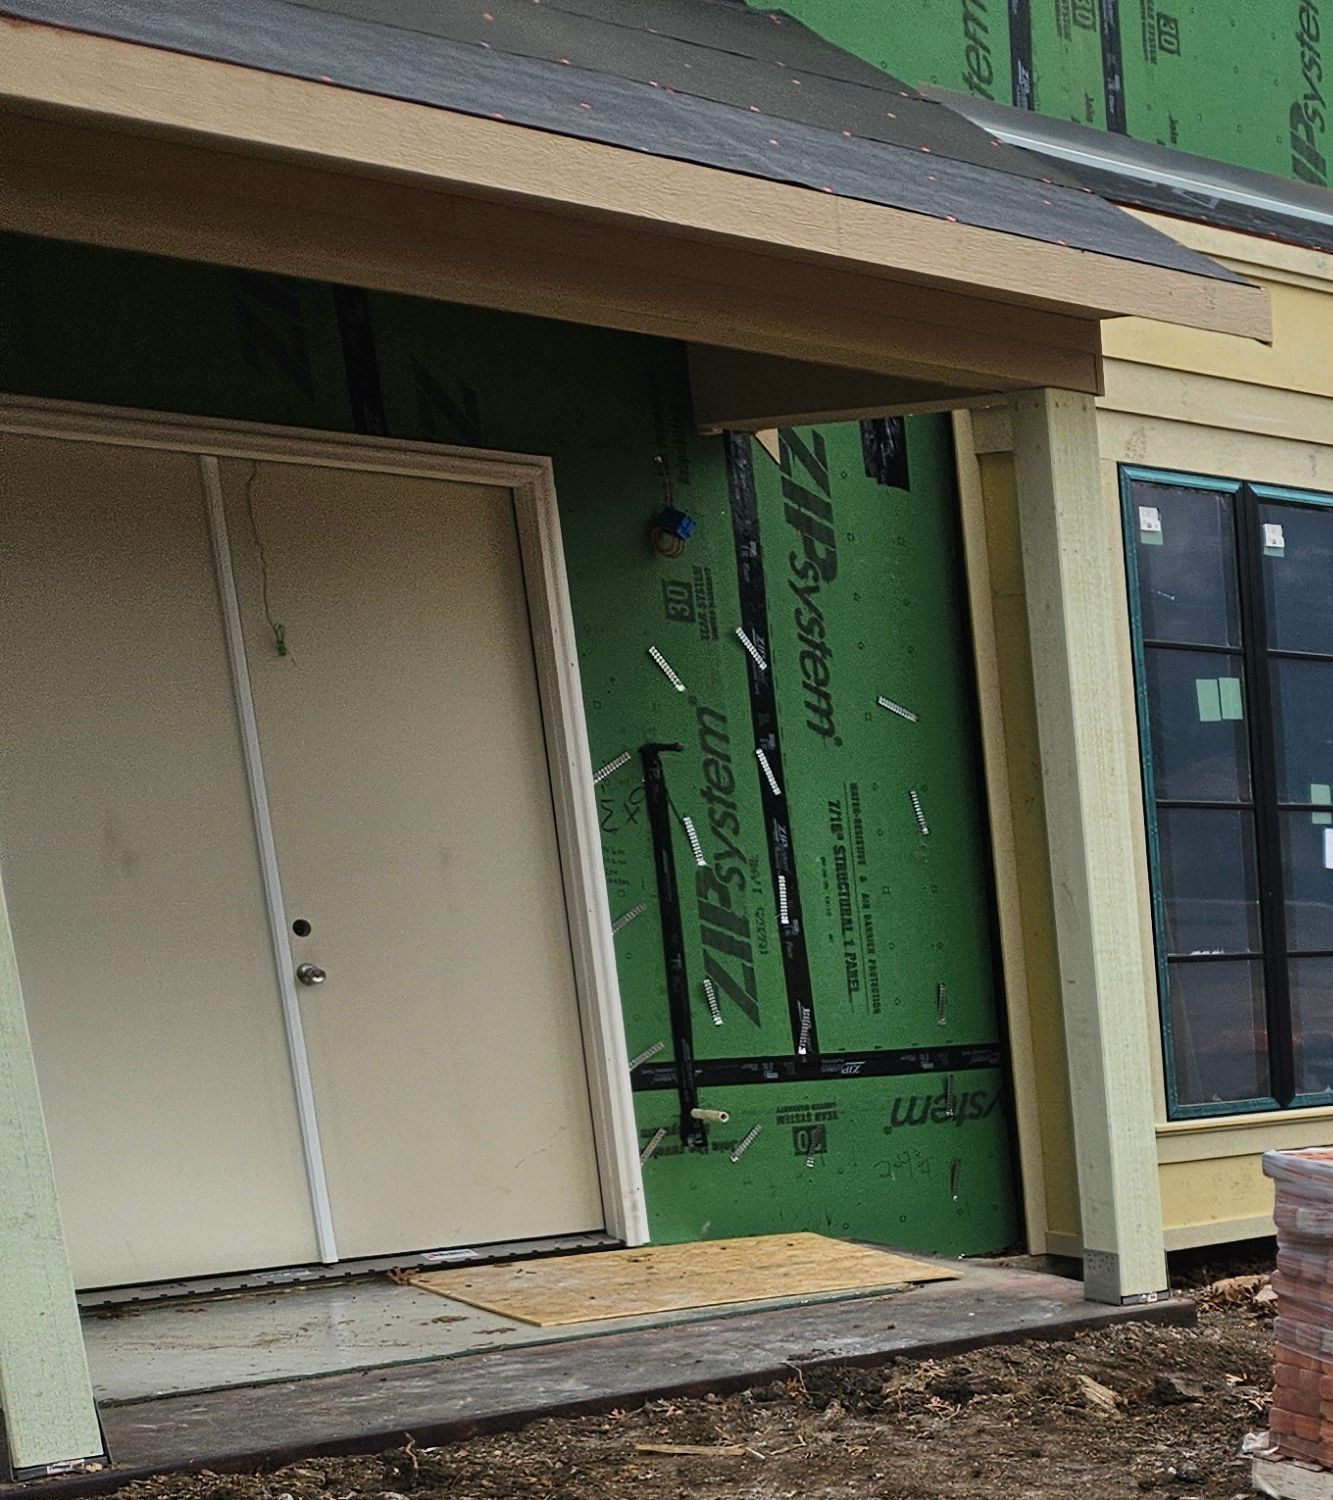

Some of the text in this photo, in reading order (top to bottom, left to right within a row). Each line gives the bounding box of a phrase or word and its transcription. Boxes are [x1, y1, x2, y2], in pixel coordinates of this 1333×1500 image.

[1158, 15, 1180, 54] 30
[832, 844, 854, 936] STRUCTURAL
[845, 951, 860, 996] PANEL
[868, 958, 882, 1014] PROTECTION
